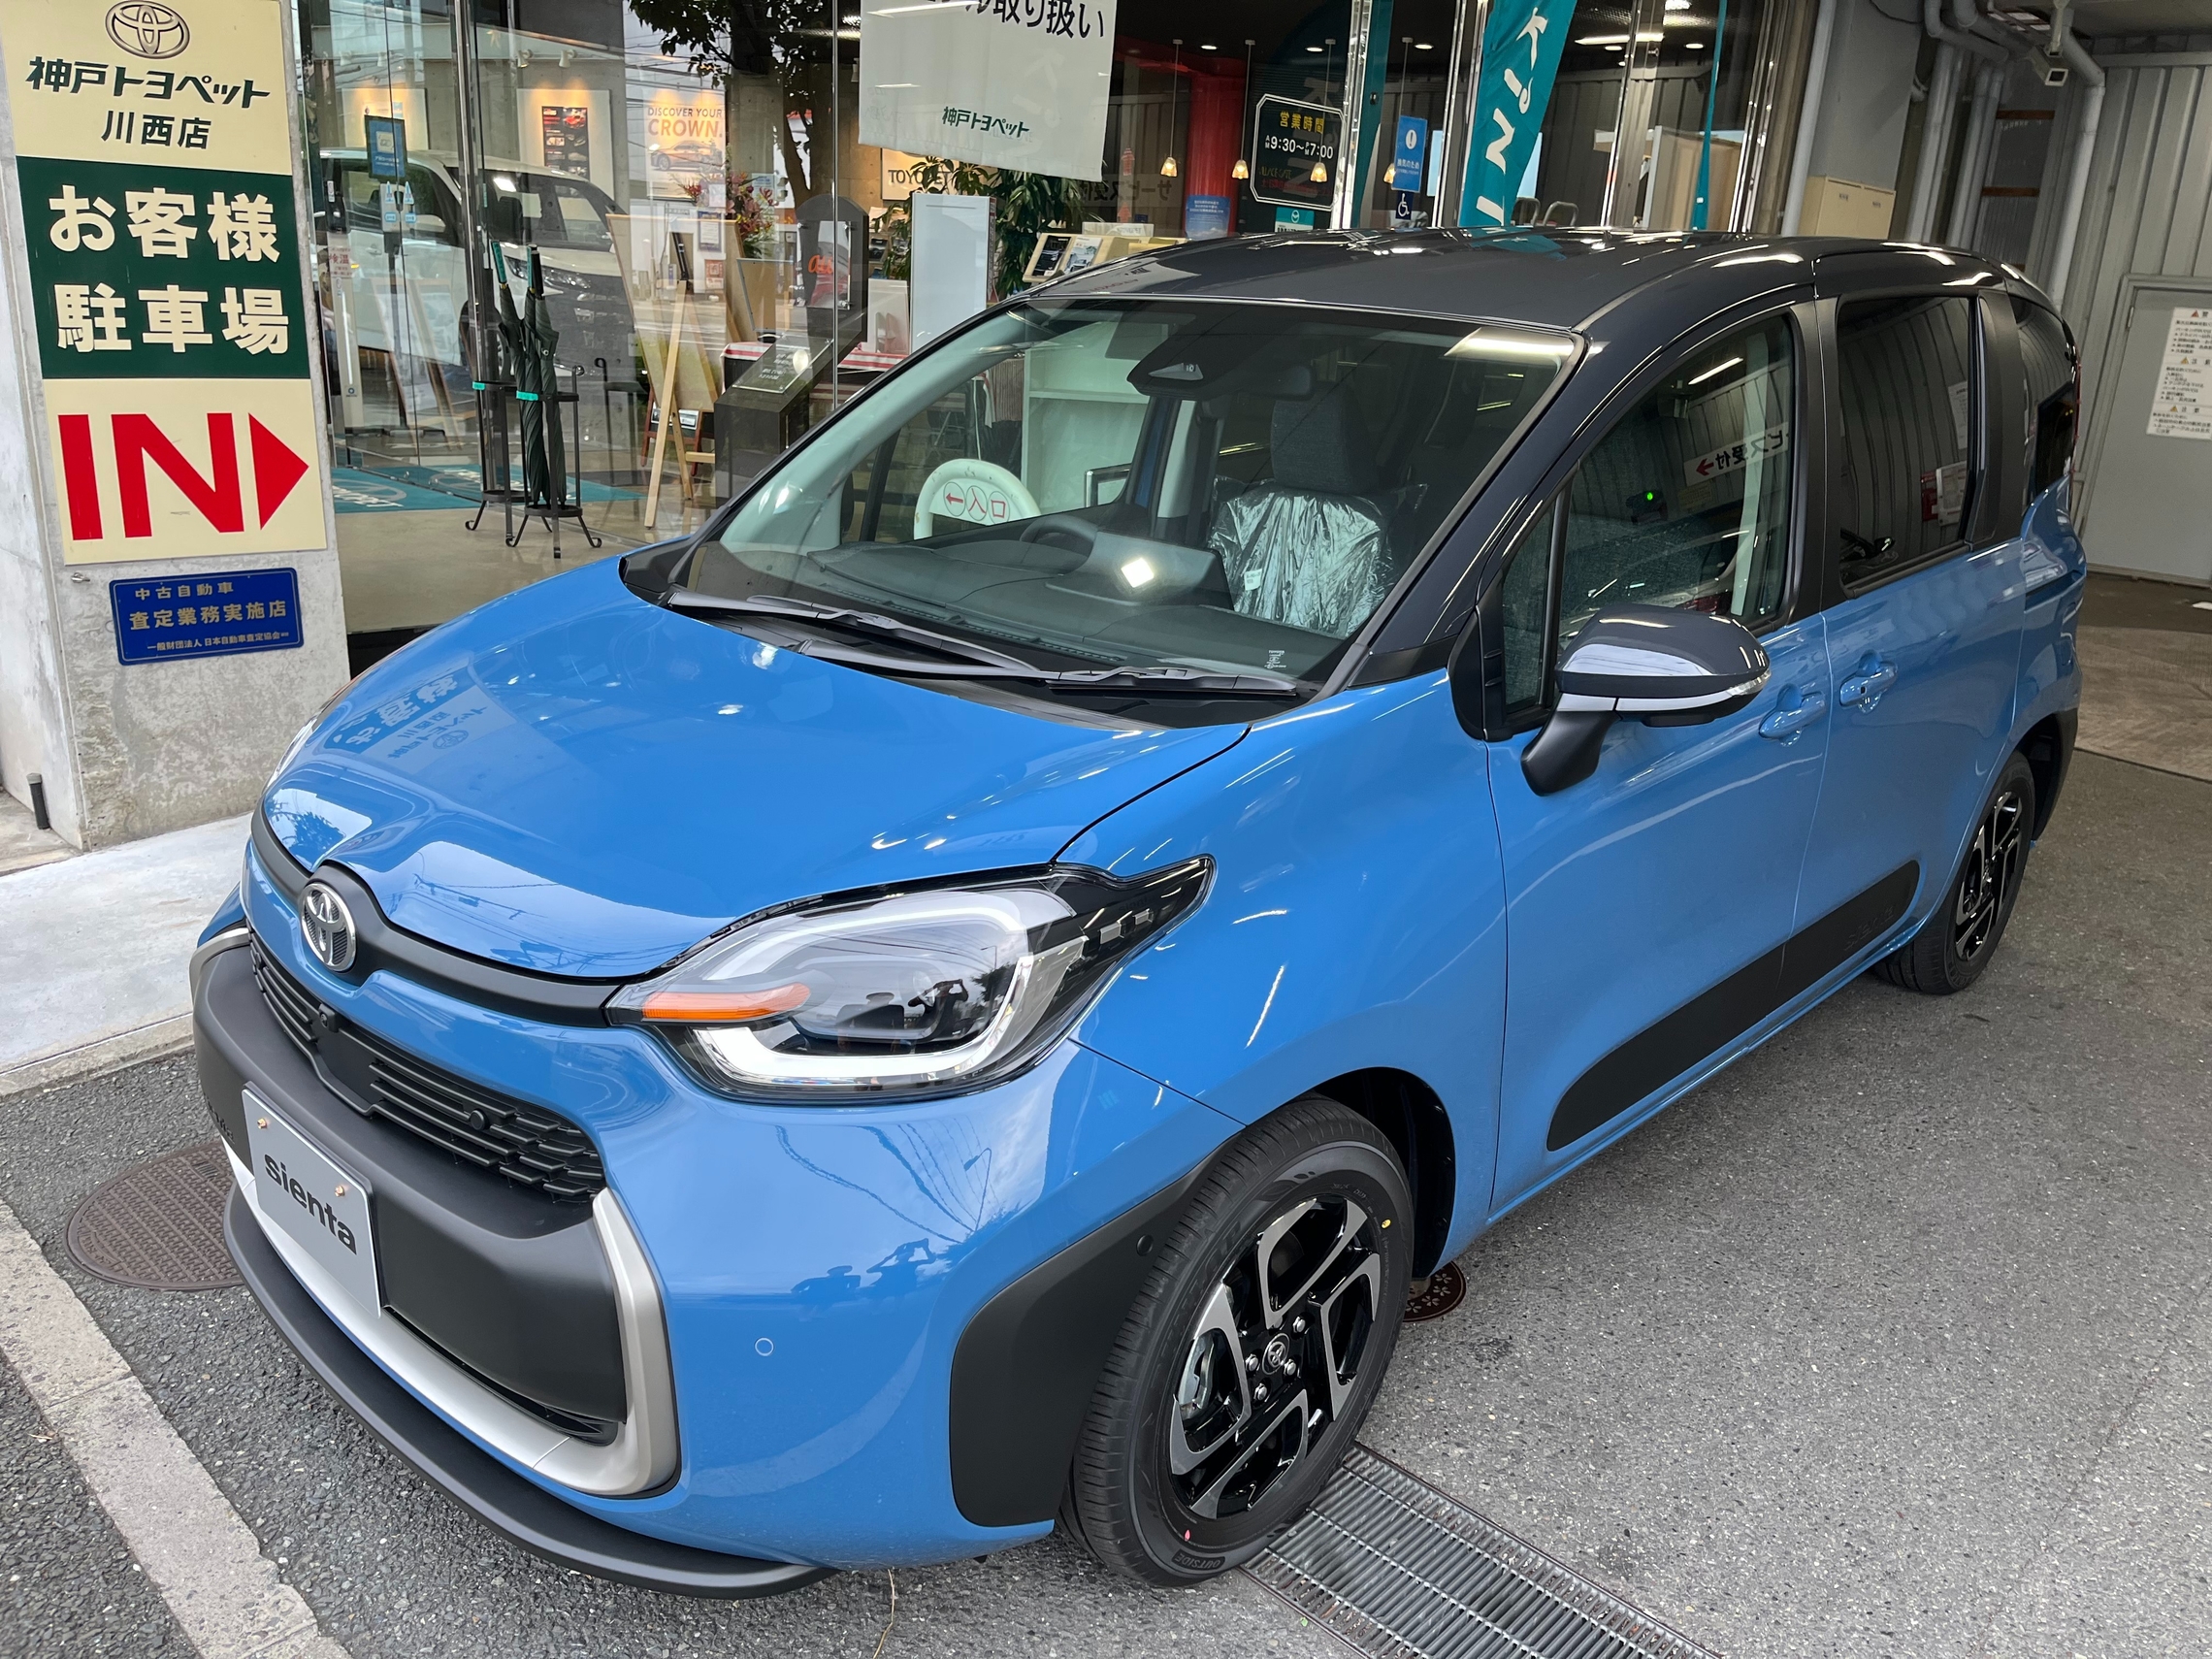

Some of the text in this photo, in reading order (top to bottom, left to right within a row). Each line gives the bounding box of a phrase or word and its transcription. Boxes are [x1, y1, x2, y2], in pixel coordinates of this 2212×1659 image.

[25, 55, 271, 109] 神戸トヨペット
[647, 107, 723, 118] DISCOVER YOUR
[647, 118, 723, 138] CROWN.
[941, 107, 1030, 138] 神戸トヨペット
[1280, 112, 1325, 134] 営業時間
[101, 110, 211, 149] 川西店
[888, 169, 952, 185] TOYOET
[49, 184, 280, 263] お客様
[53, 282, 288, 355] 駐車場
[57, 412, 244, 540] IN
[968, 488, 1006, 518] 入口
[135, 581, 234, 601] 中古自動車
[129, 600, 286, 631] 査定業務実施店
[147, 638, 202, 651] 一般財団法人
[264, 1155, 357, 1255] sienta
